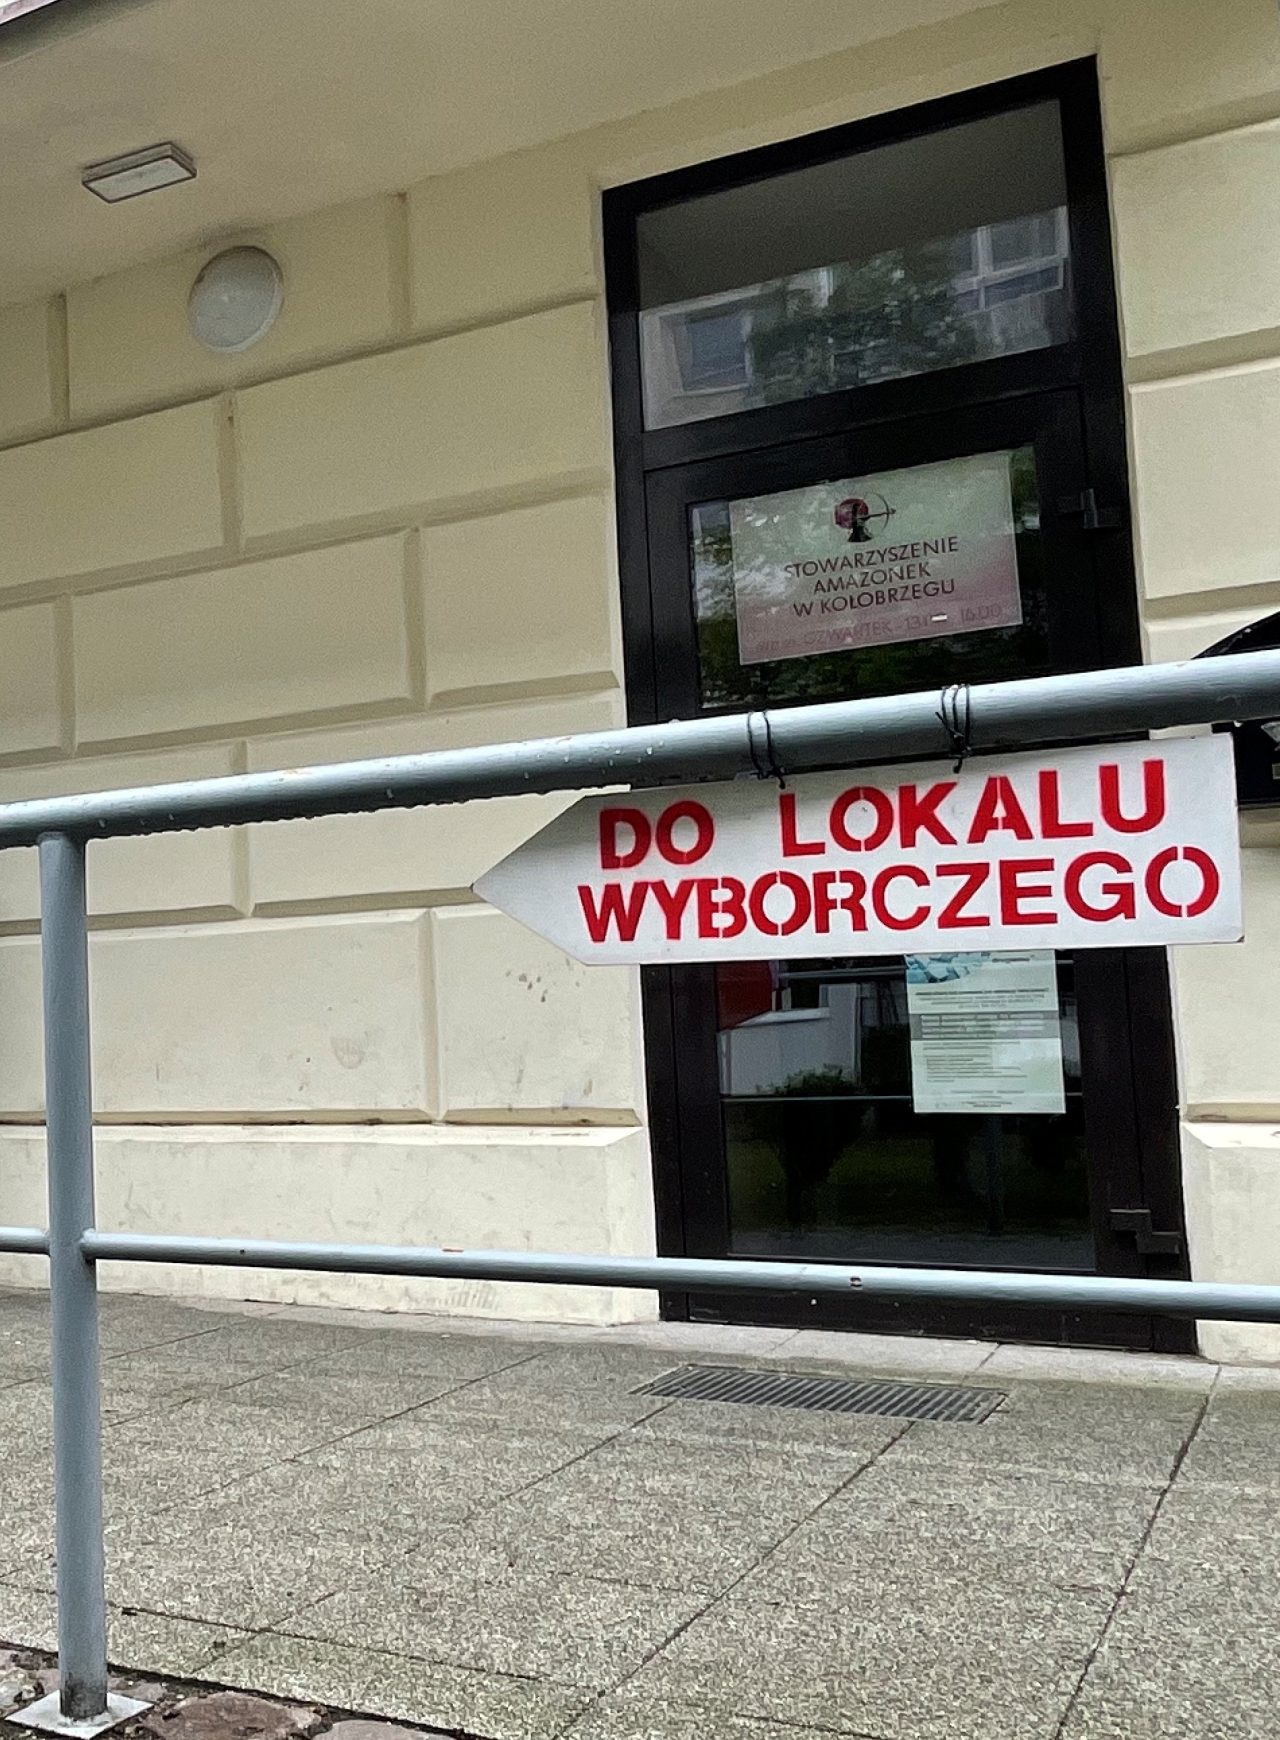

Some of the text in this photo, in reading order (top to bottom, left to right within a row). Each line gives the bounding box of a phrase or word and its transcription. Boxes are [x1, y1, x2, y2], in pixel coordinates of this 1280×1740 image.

[783, 537, 959, 579] STOWARZYSZENIE
[813, 562, 932, 594] AMAZONEK
[793, 602, 813, 617] W
[599, 759, 1166, 870] DO LOKALU
[578, 846, 1220, 944] WYBORCZEGO
